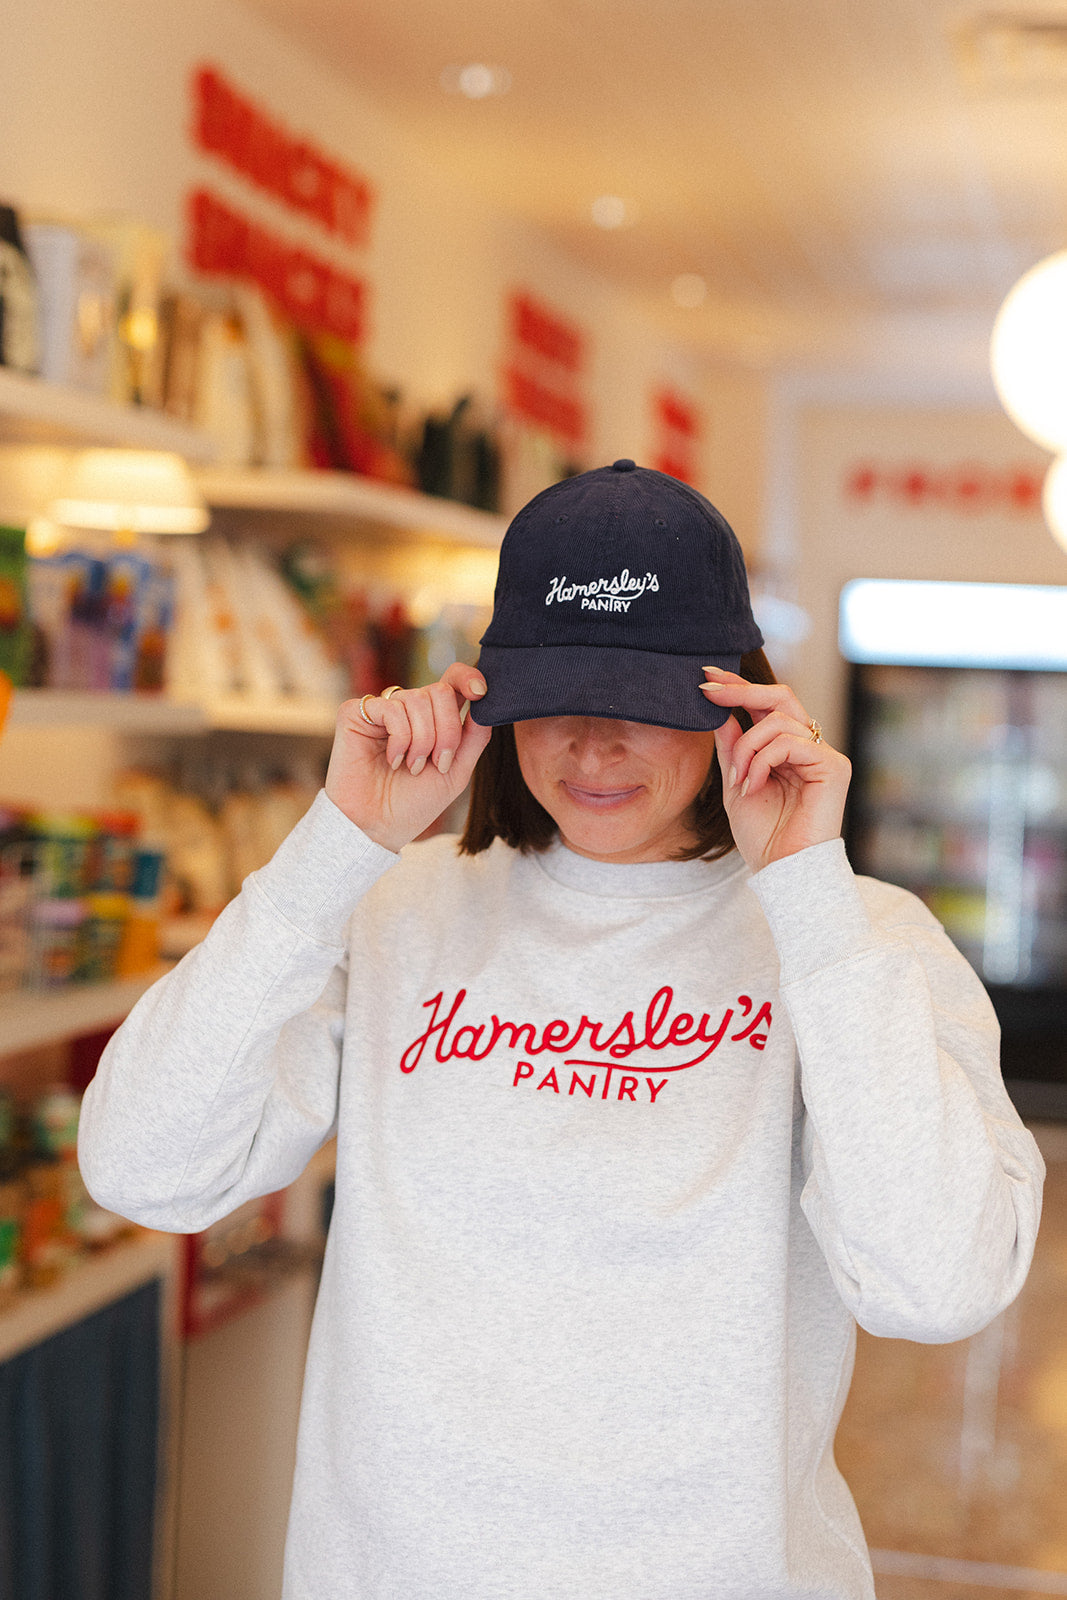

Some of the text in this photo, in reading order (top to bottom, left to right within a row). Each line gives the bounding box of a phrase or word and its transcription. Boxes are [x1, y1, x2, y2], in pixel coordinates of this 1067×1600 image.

[545, 568, 660, 606] Hamersley's
[580, 598, 632, 612] PANTRY
[400, 985, 773, 1074] Hamersley's
[512, 1060, 669, 1104] PANTRY
